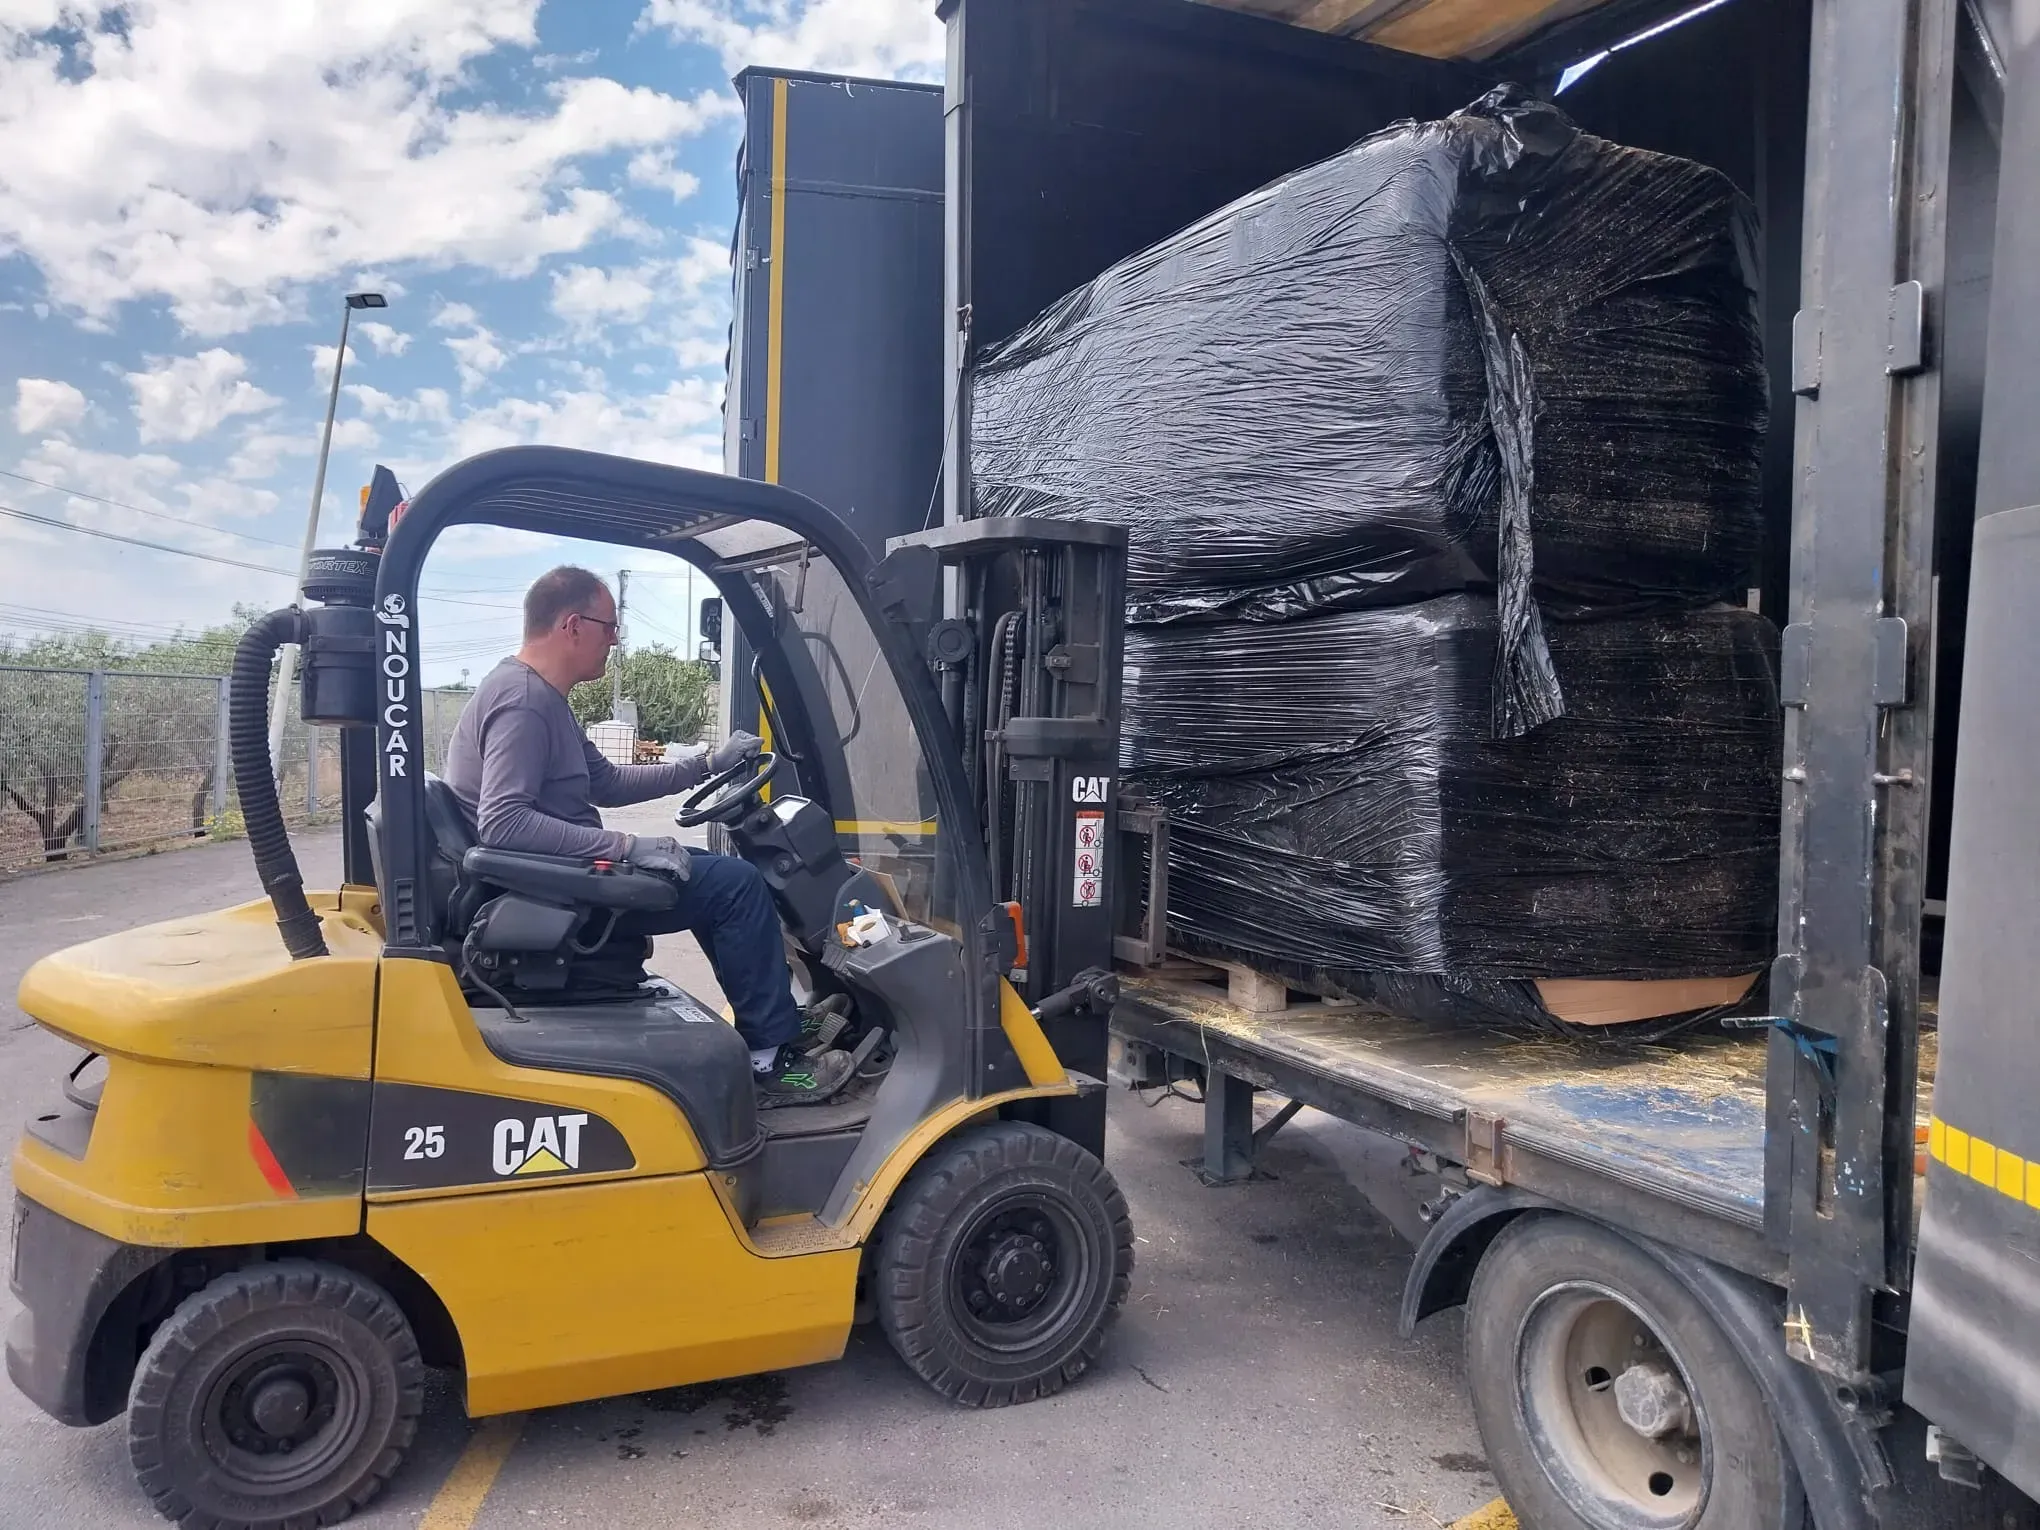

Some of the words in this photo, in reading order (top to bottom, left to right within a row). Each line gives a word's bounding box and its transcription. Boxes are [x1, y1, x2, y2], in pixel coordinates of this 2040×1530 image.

[383, 631, 409, 777] NOUCAR
[1072, 776, 1110, 802] CAT
[404, 1125, 445, 1160] 25
[492, 1113, 588, 1176] CAT
